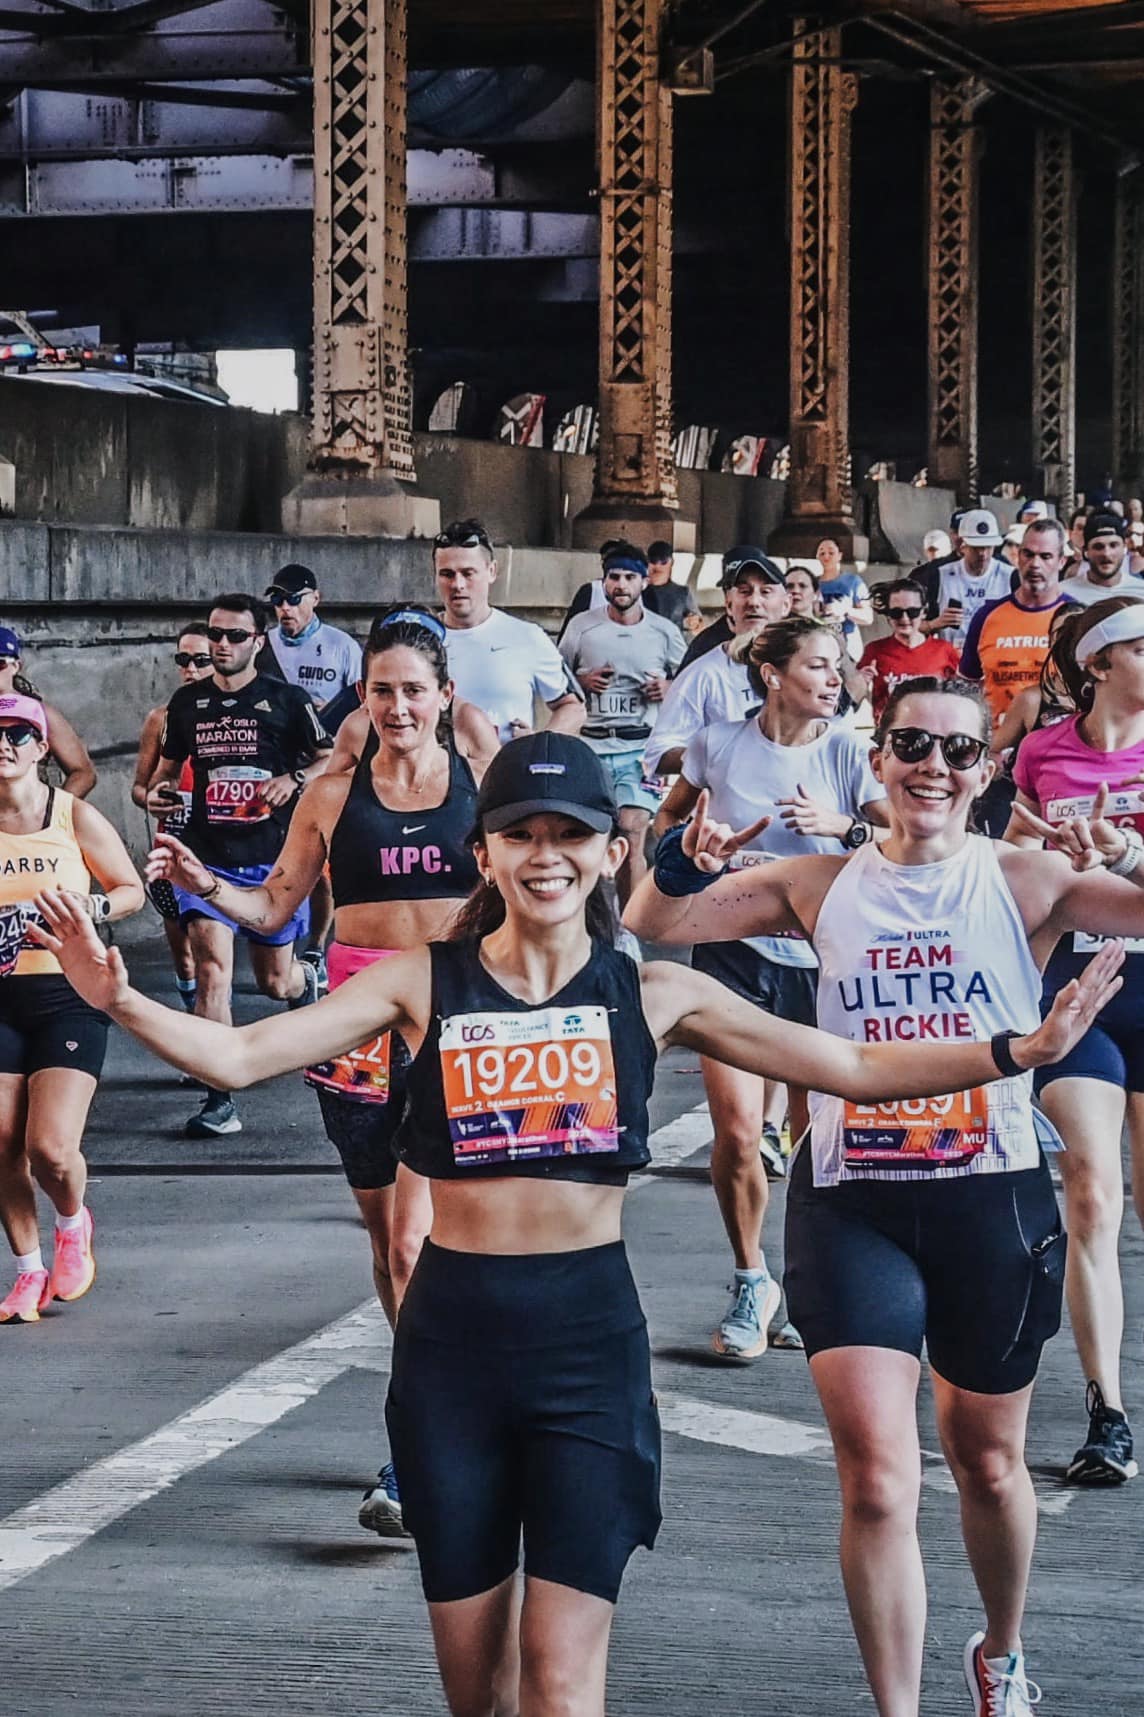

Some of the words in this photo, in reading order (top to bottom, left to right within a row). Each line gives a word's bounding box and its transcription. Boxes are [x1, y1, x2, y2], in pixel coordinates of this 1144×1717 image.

[598, 695, 638, 714] LUKE
[233, 719, 258, 727] OSLO
[196, 729, 258, 744] MARATON
[0, 857, 59, 875] ARBY
[380, 845, 452, 875] KPC.
[913, 930, 951, 940] ULTRA
[866, 944, 952, 970] TEAM
[838, 971, 992, 1012] ULTRA
[864, 1012, 972, 1043] RICKIE
[454, 1042, 601, 1098] 19209
[474, 1101, 483, 1112] 2
[555, 1091, 565, 1102] C
